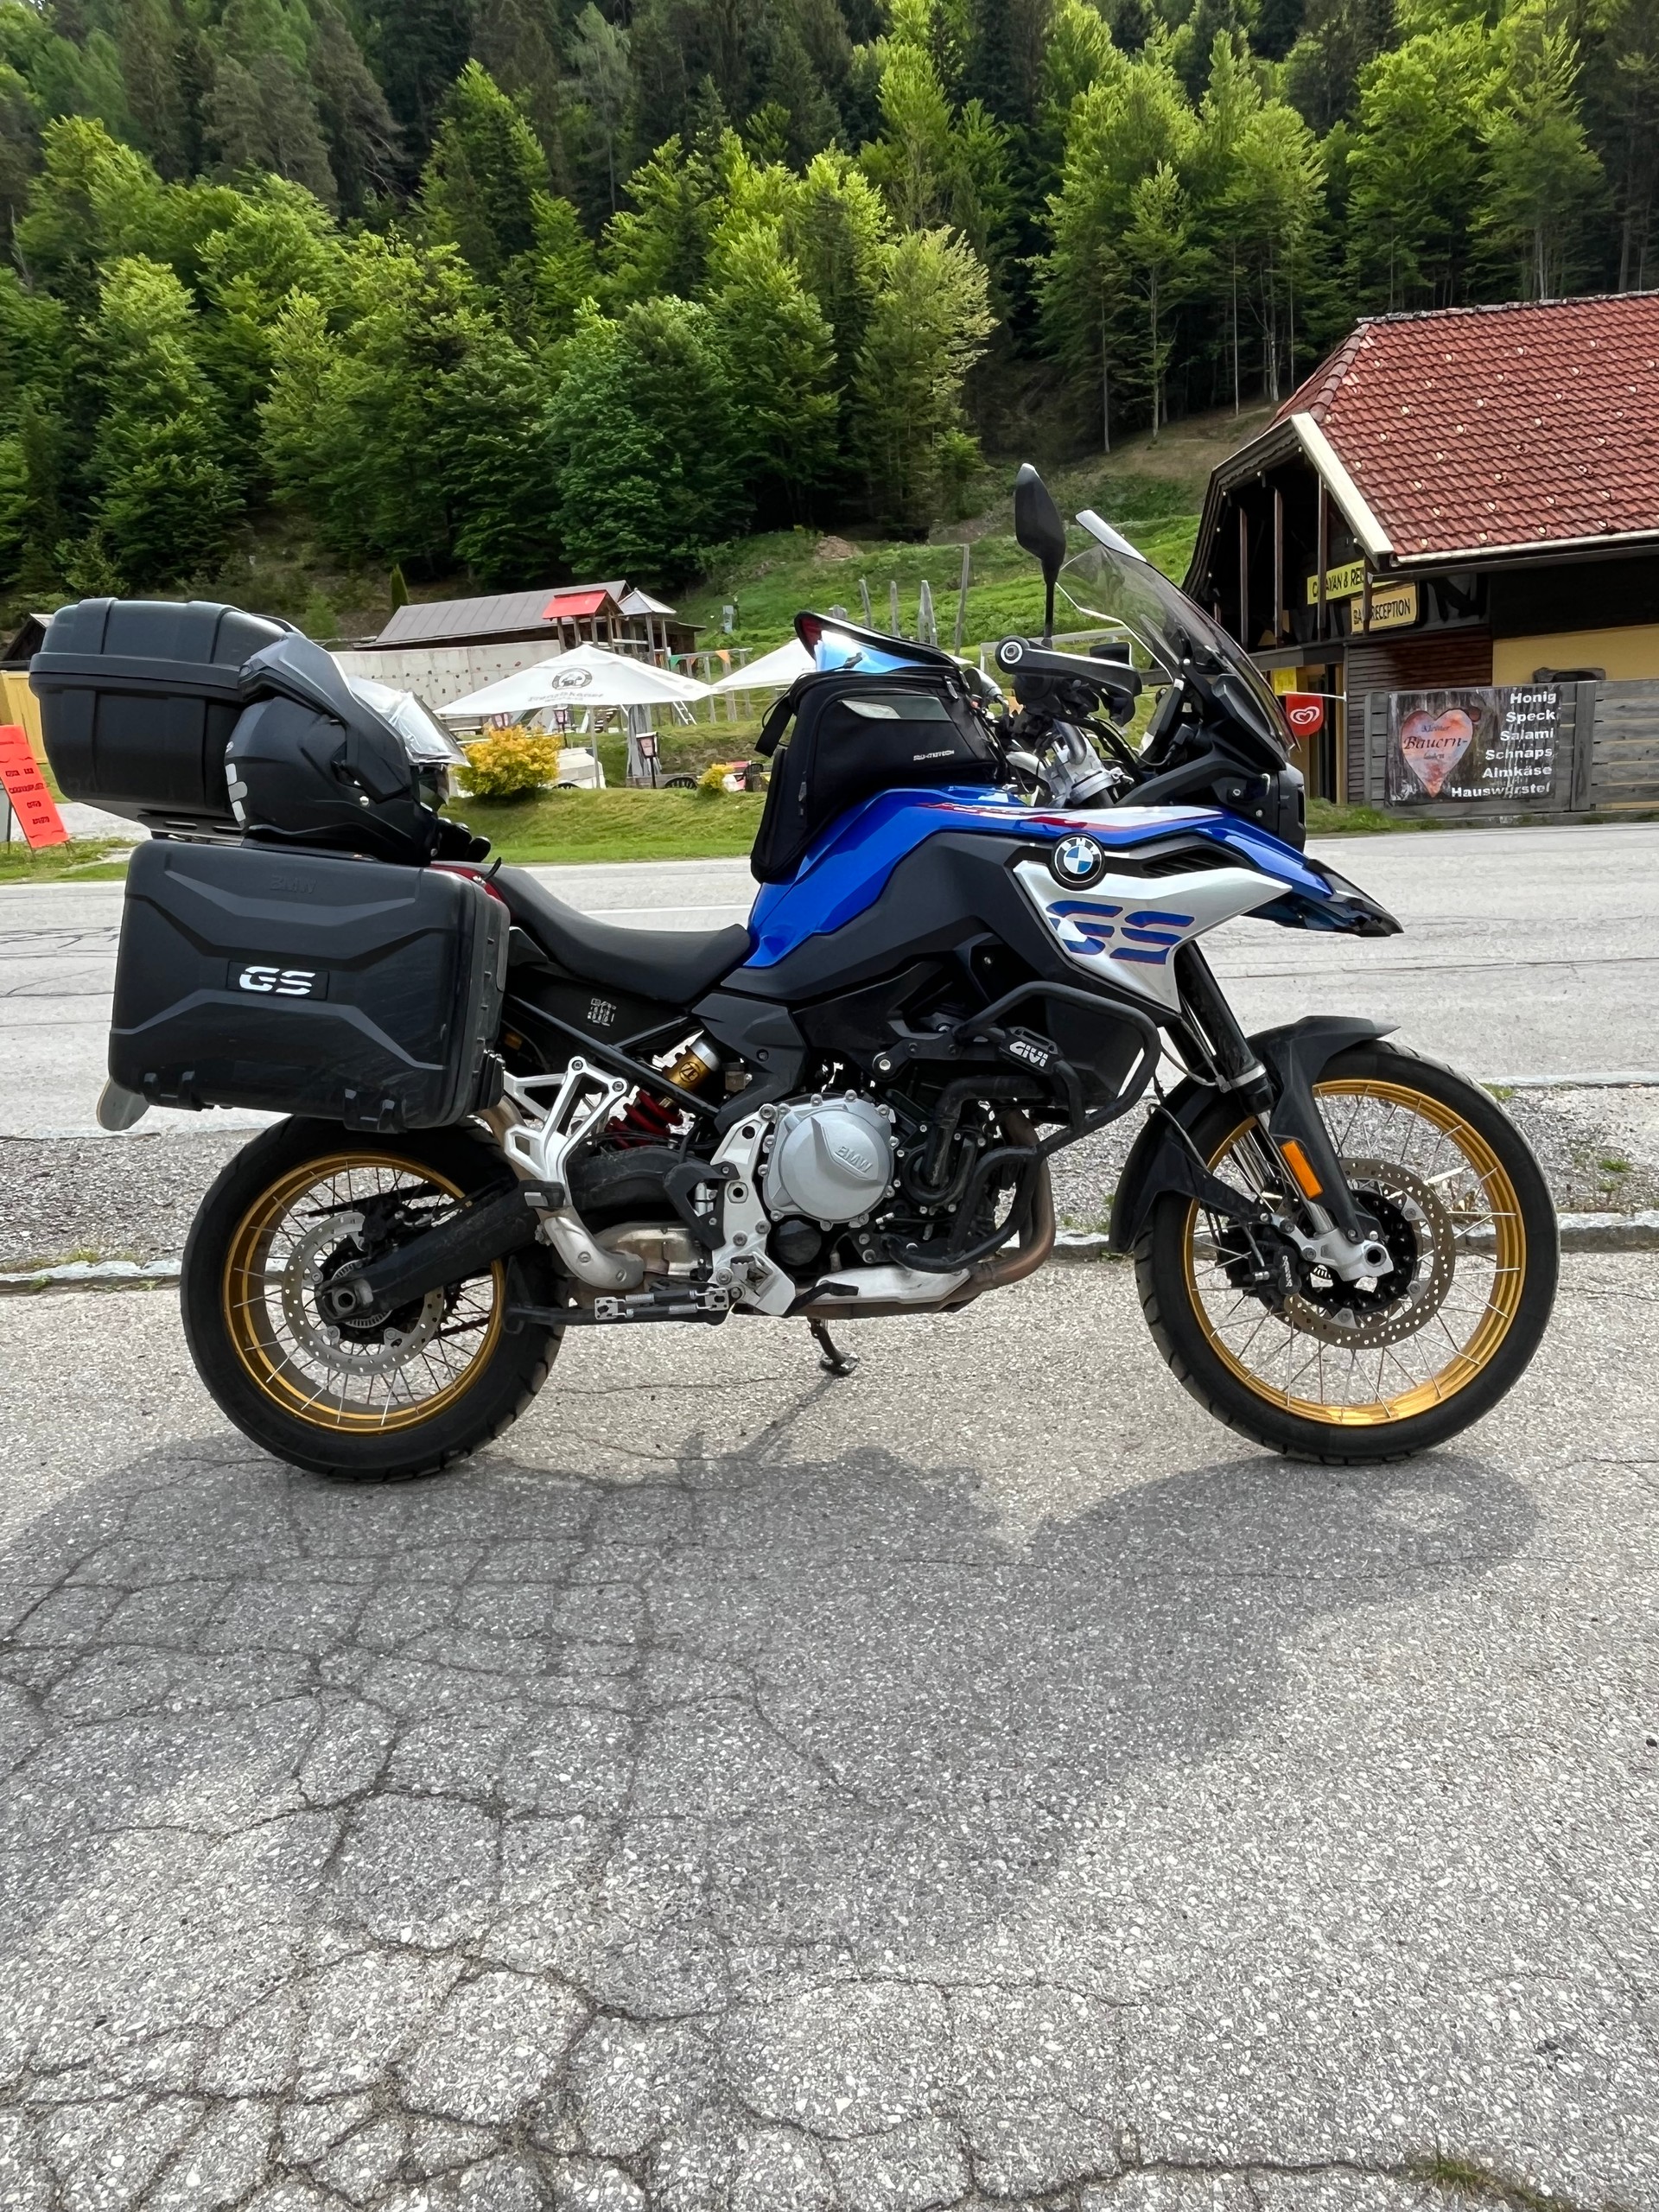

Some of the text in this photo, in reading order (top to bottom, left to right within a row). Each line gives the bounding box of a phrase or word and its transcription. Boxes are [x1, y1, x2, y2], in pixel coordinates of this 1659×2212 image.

[1510, 691, 1556, 704] Honig
[1506, 709, 1555, 724] Speck
[1500, 728, 1554, 741] Salami
[1485, 747, 1553, 760] Schnaps
[1482, 765, 1553, 779] Almkäse
[1060, 836, 1100, 855] BMW
[1046, 899, 1196, 965] GS
[239, 965, 316, 995] GS
[1009, 1040, 1049, 1067] GIVI
[836, 1146, 873, 1173] BMW
